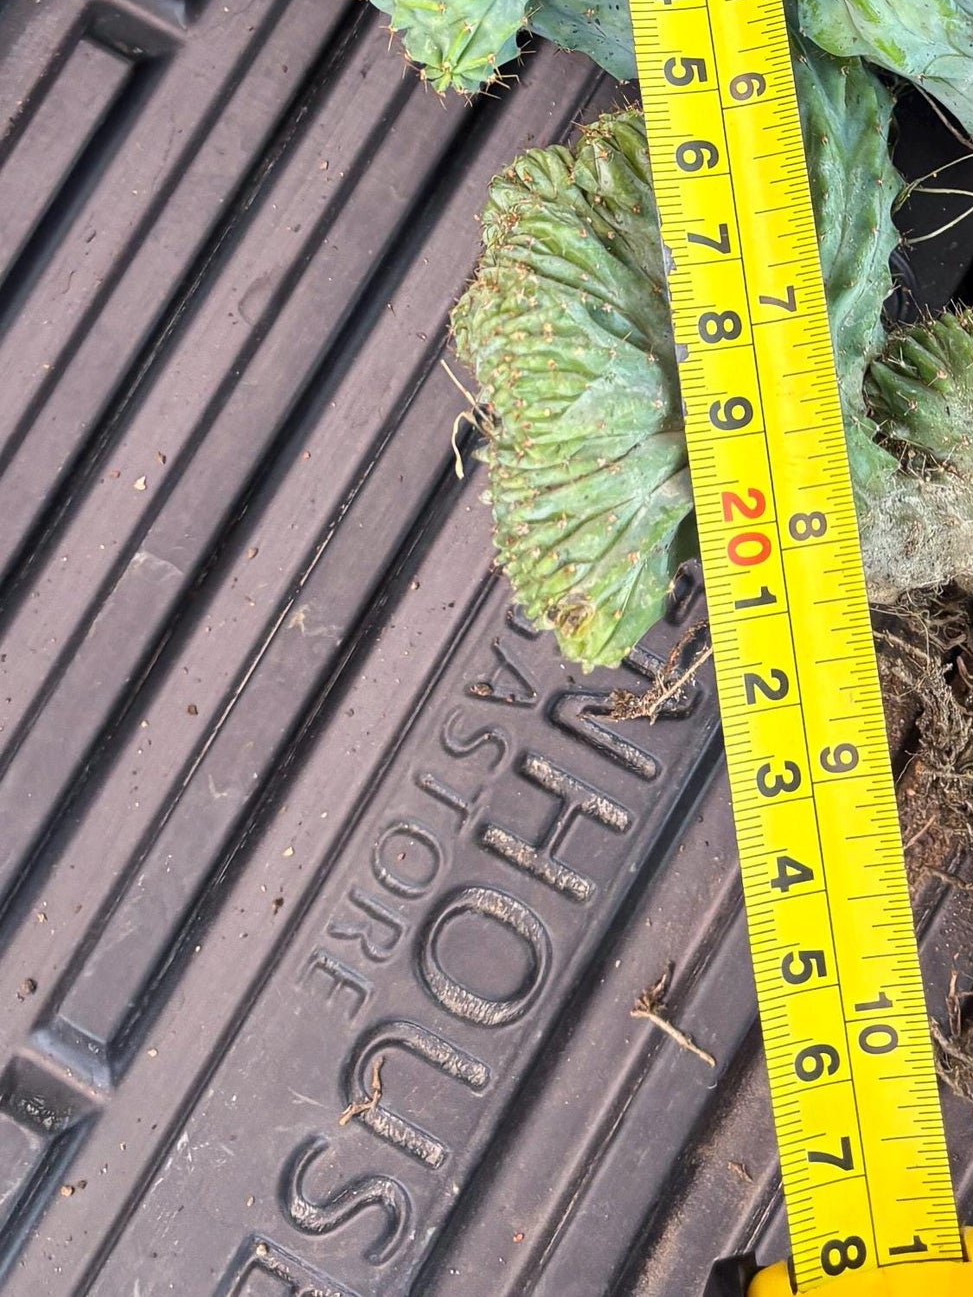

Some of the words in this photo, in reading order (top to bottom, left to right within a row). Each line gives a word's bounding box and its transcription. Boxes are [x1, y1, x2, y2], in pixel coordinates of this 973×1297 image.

[663, 56, 708, 87] 5
[729, 72, 767, 102] 6
[675, 140, 719, 173] 6
[687, 223, 731, 254] 7
[758, 285, 798, 313] 7
[697, 310, 742, 344] 8
[709, 396, 754, 431] 9
[721, 487, 772, 567] 20
[788, 511, 828, 542] 8
[734, 586, 778, 610] 1
[743, 668, 790, 705] 2
[819, 743, 860, 774] 9
[756, 760, 801, 798] 3
[771, 856, 815, 893] 4
[781, 949, 828, 985] 5
[854, 991, 899, 1055] 10
[794, 1043, 841, 1082] 6
[807, 1136, 855, 1172] 7
[820, 1235, 867, 1277] 8
[888, 1235, 929, 1256] 1
